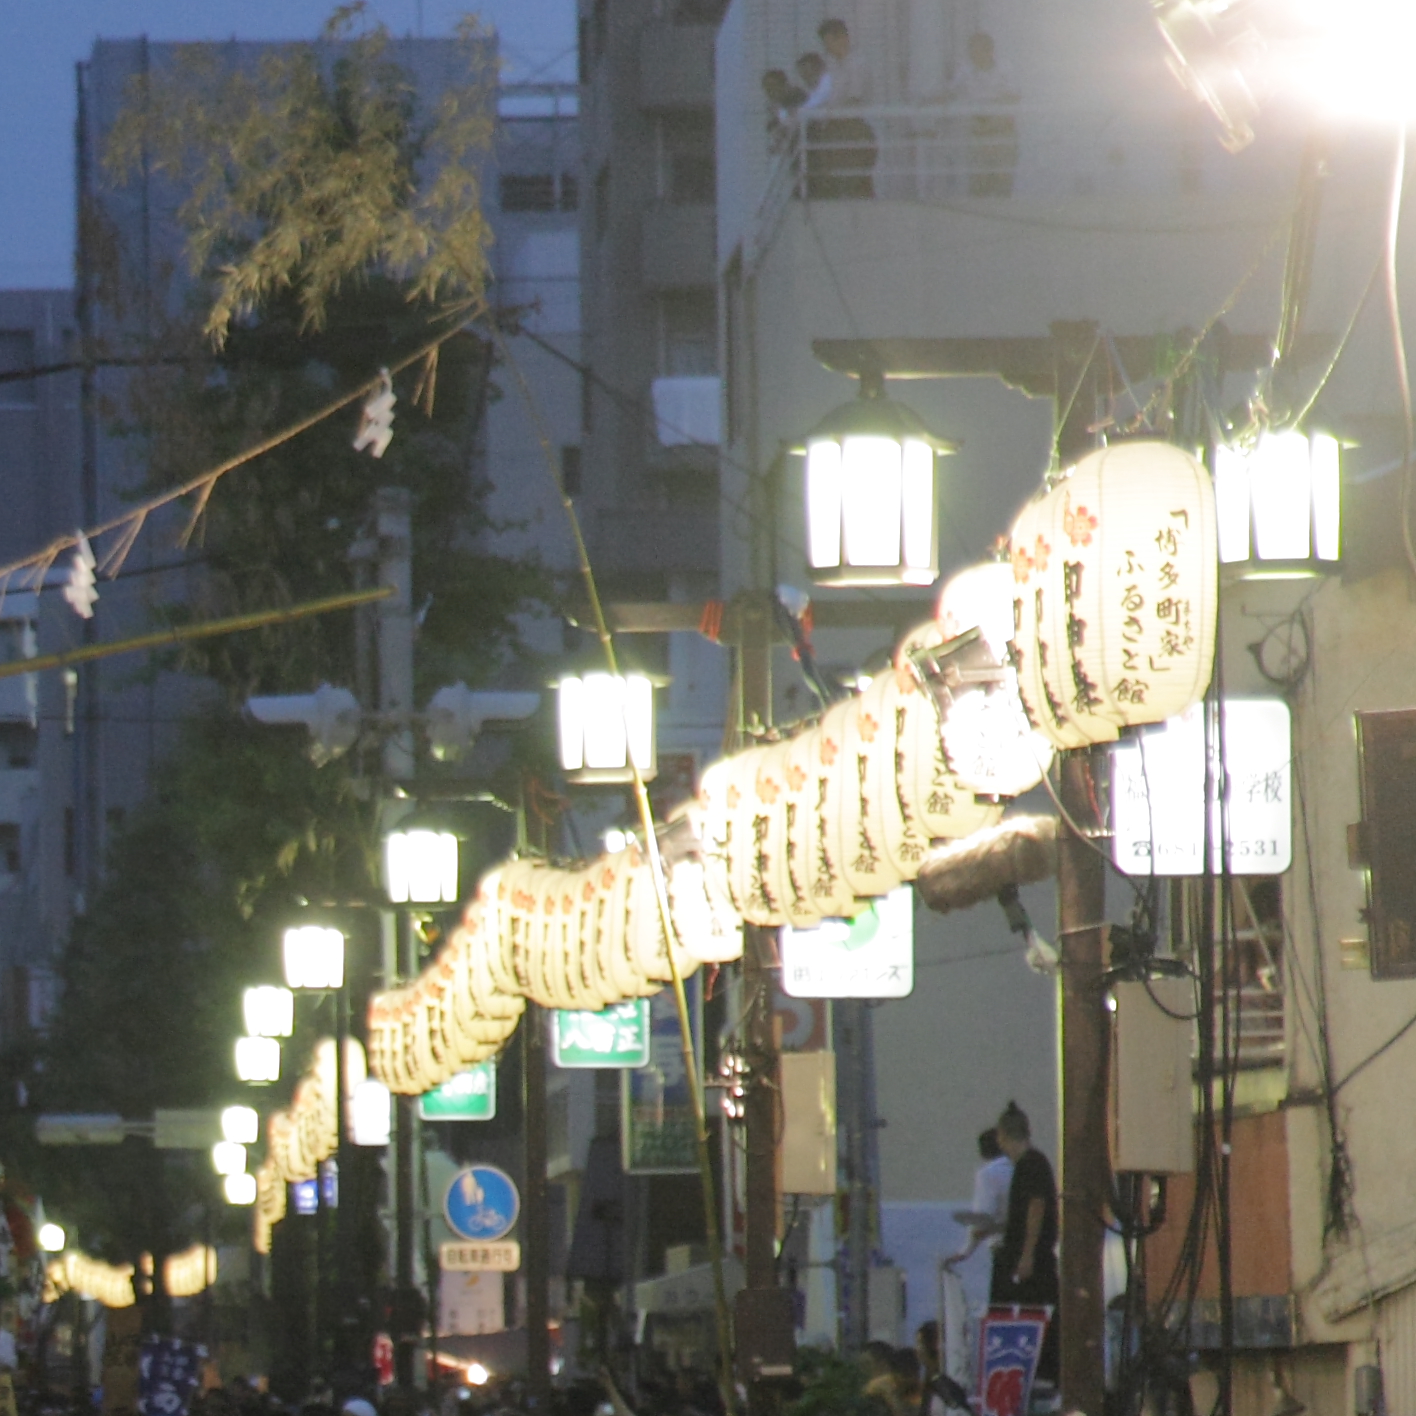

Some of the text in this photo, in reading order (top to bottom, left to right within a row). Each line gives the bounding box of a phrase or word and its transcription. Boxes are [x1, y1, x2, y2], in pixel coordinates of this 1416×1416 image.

[1111, 550, 1150, 705] ふるさと館
